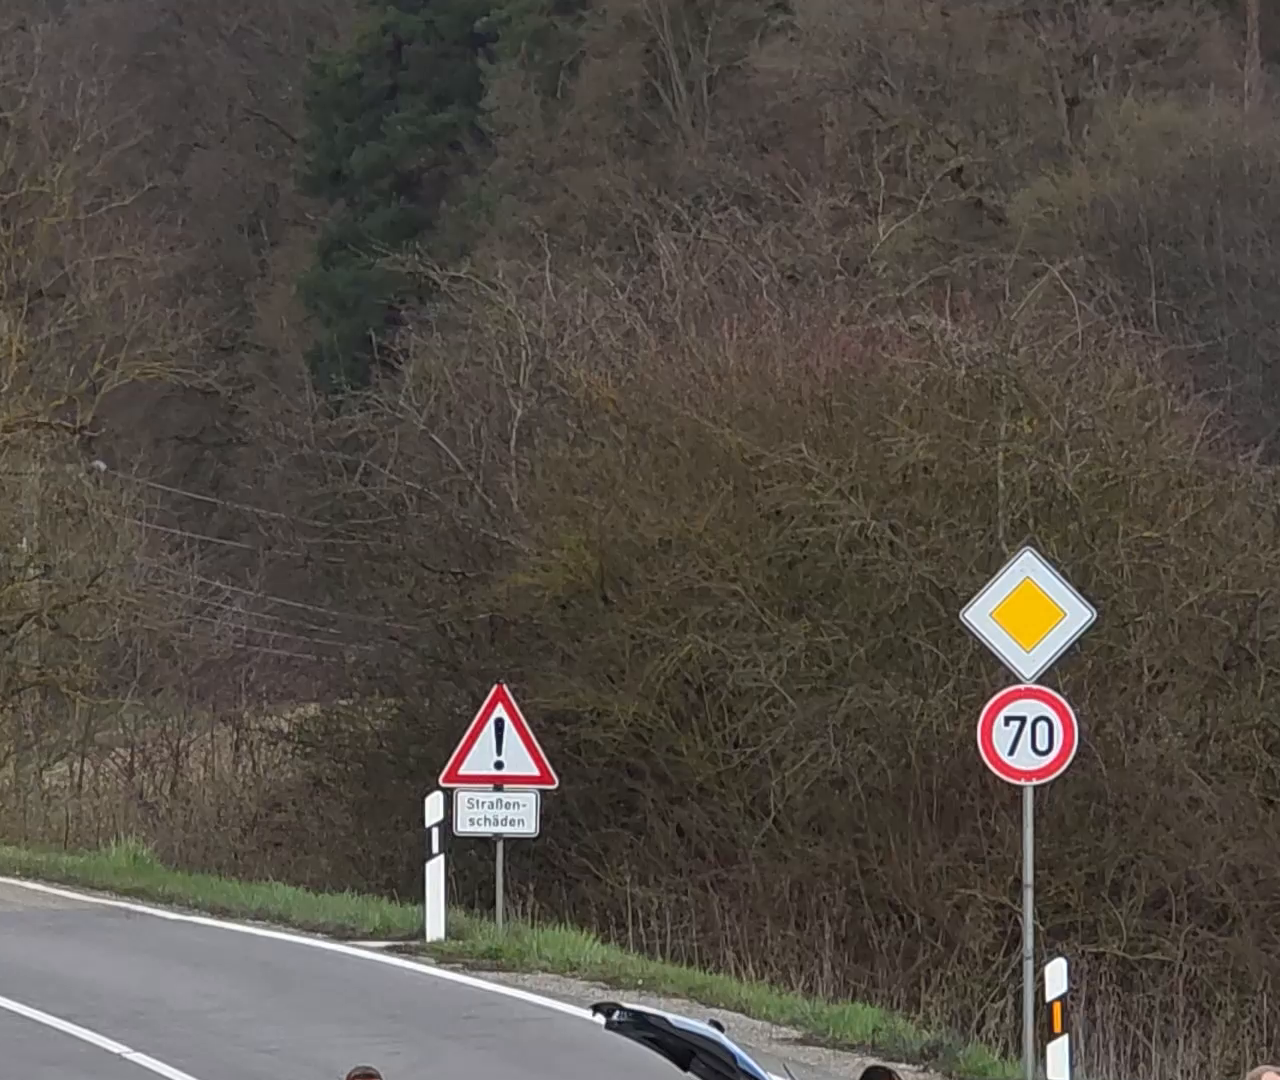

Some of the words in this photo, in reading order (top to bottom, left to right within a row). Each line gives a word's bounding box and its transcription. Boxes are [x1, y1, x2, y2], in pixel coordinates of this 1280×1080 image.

[1003, 715, 1054, 757] 70
[466, 797, 527, 811] Straßen-
[468, 814, 525, 828] schäden
